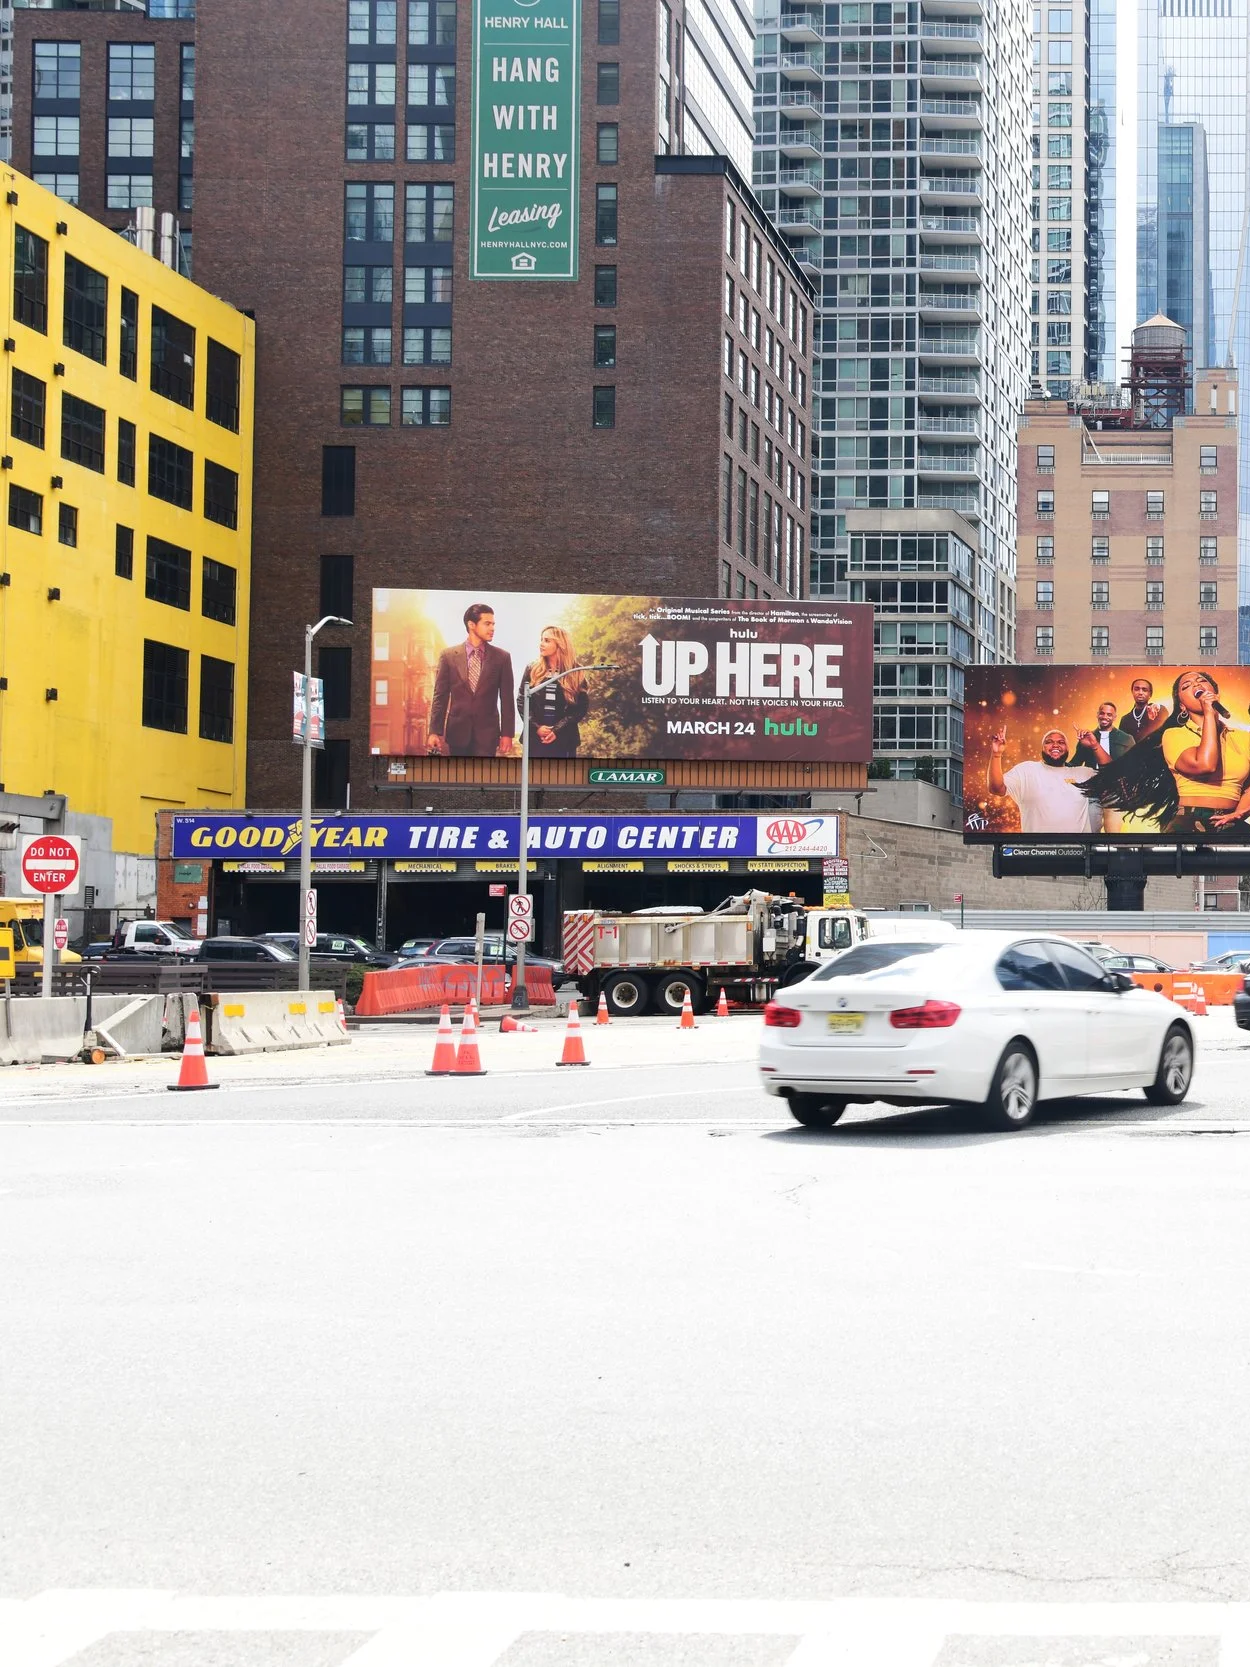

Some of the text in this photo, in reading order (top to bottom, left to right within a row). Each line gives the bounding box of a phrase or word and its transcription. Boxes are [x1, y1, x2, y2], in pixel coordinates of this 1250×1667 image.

[485, 17, 568, 28] HENRY HALL
[493, 57, 559, 82] HANG
[493, 105, 557, 130] WITH
[484, 153, 567, 178] HENRY
[488, 203, 562, 232] Leasing
[729, 628, 758, 639] hulu
[638, 634, 844, 699] UP HERE
[702, 698, 727, 706] HEART.
[667, 718, 818, 736] MARCH 24 hulu
[597, 772, 658, 782] LAMAR
[409, 826, 480, 849] TIRE
[487, 829, 510, 849] &
[527, 826, 607, 849] AUTO
[617, 826, 739, 849] CENTER
[771, 820, 802, 844] AAA
[30, 847, 71, 857] DO NOT
[1013, 848, 1083, 856] Clear Channel Outdoor
[33, 873, 66, 882] ENTER
[597, 925, 617, 939] T-1
